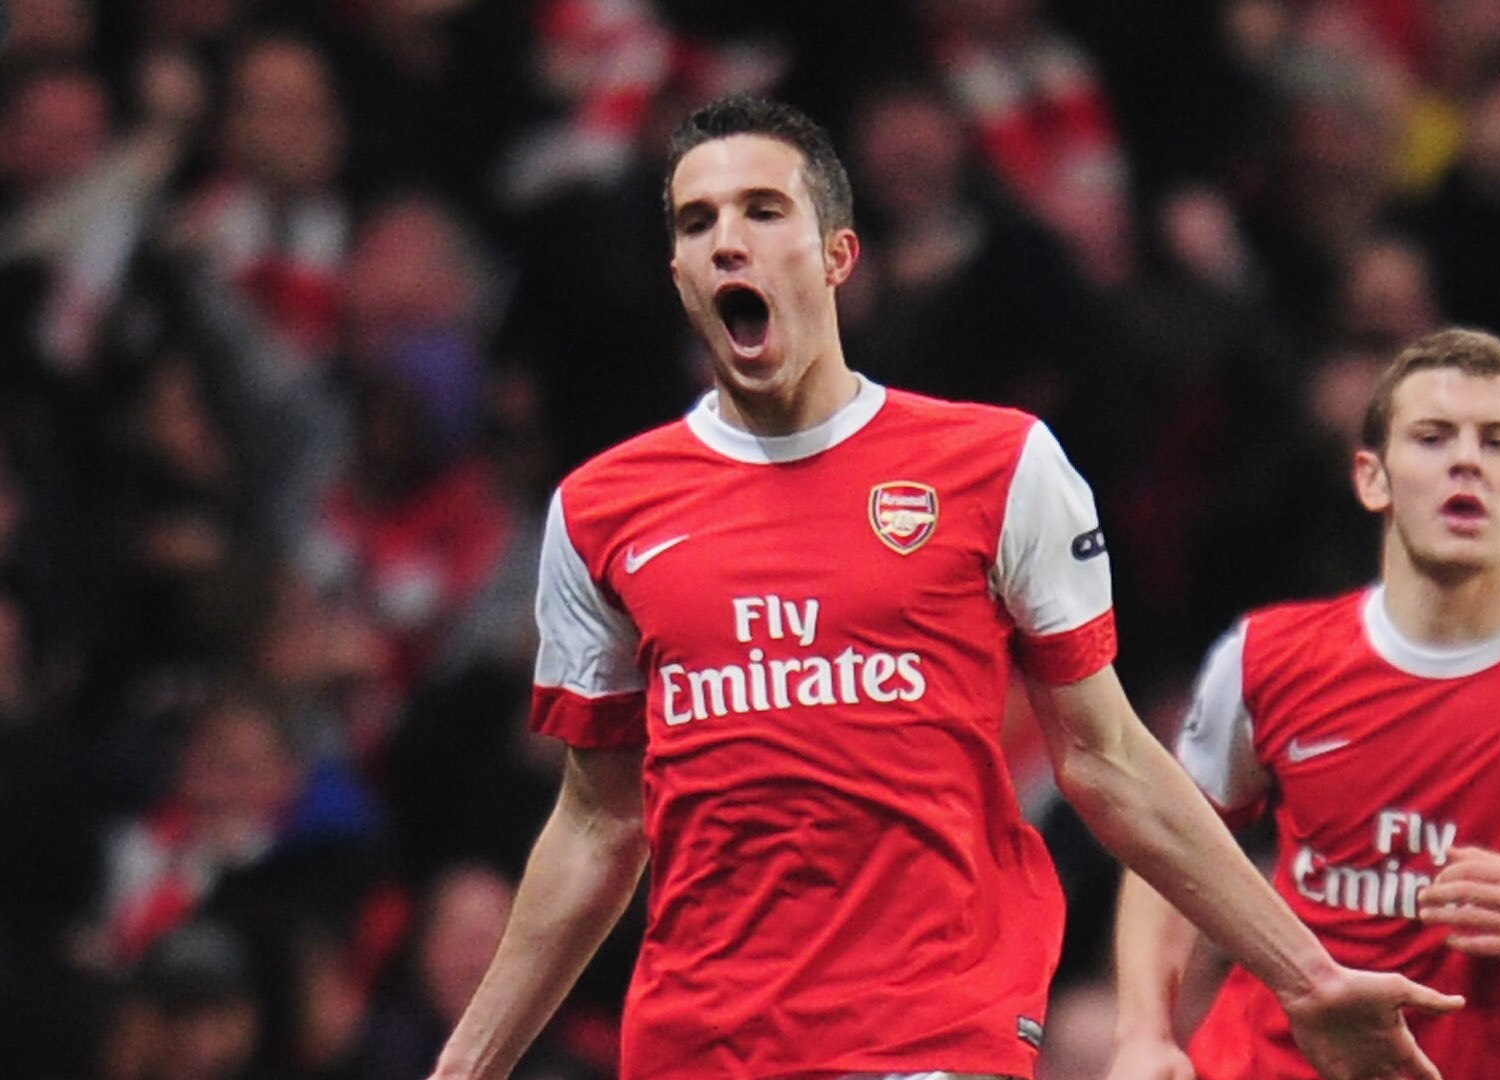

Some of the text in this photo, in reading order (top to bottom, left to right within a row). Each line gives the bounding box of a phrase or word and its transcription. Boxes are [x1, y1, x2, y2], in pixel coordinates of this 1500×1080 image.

[732, 594, 820, 647] Fly
[659, 647, 927, 726] Emirates
[1376, 811, 1457, 866] Fly
[1293, 846, 1432, 918] Emir
